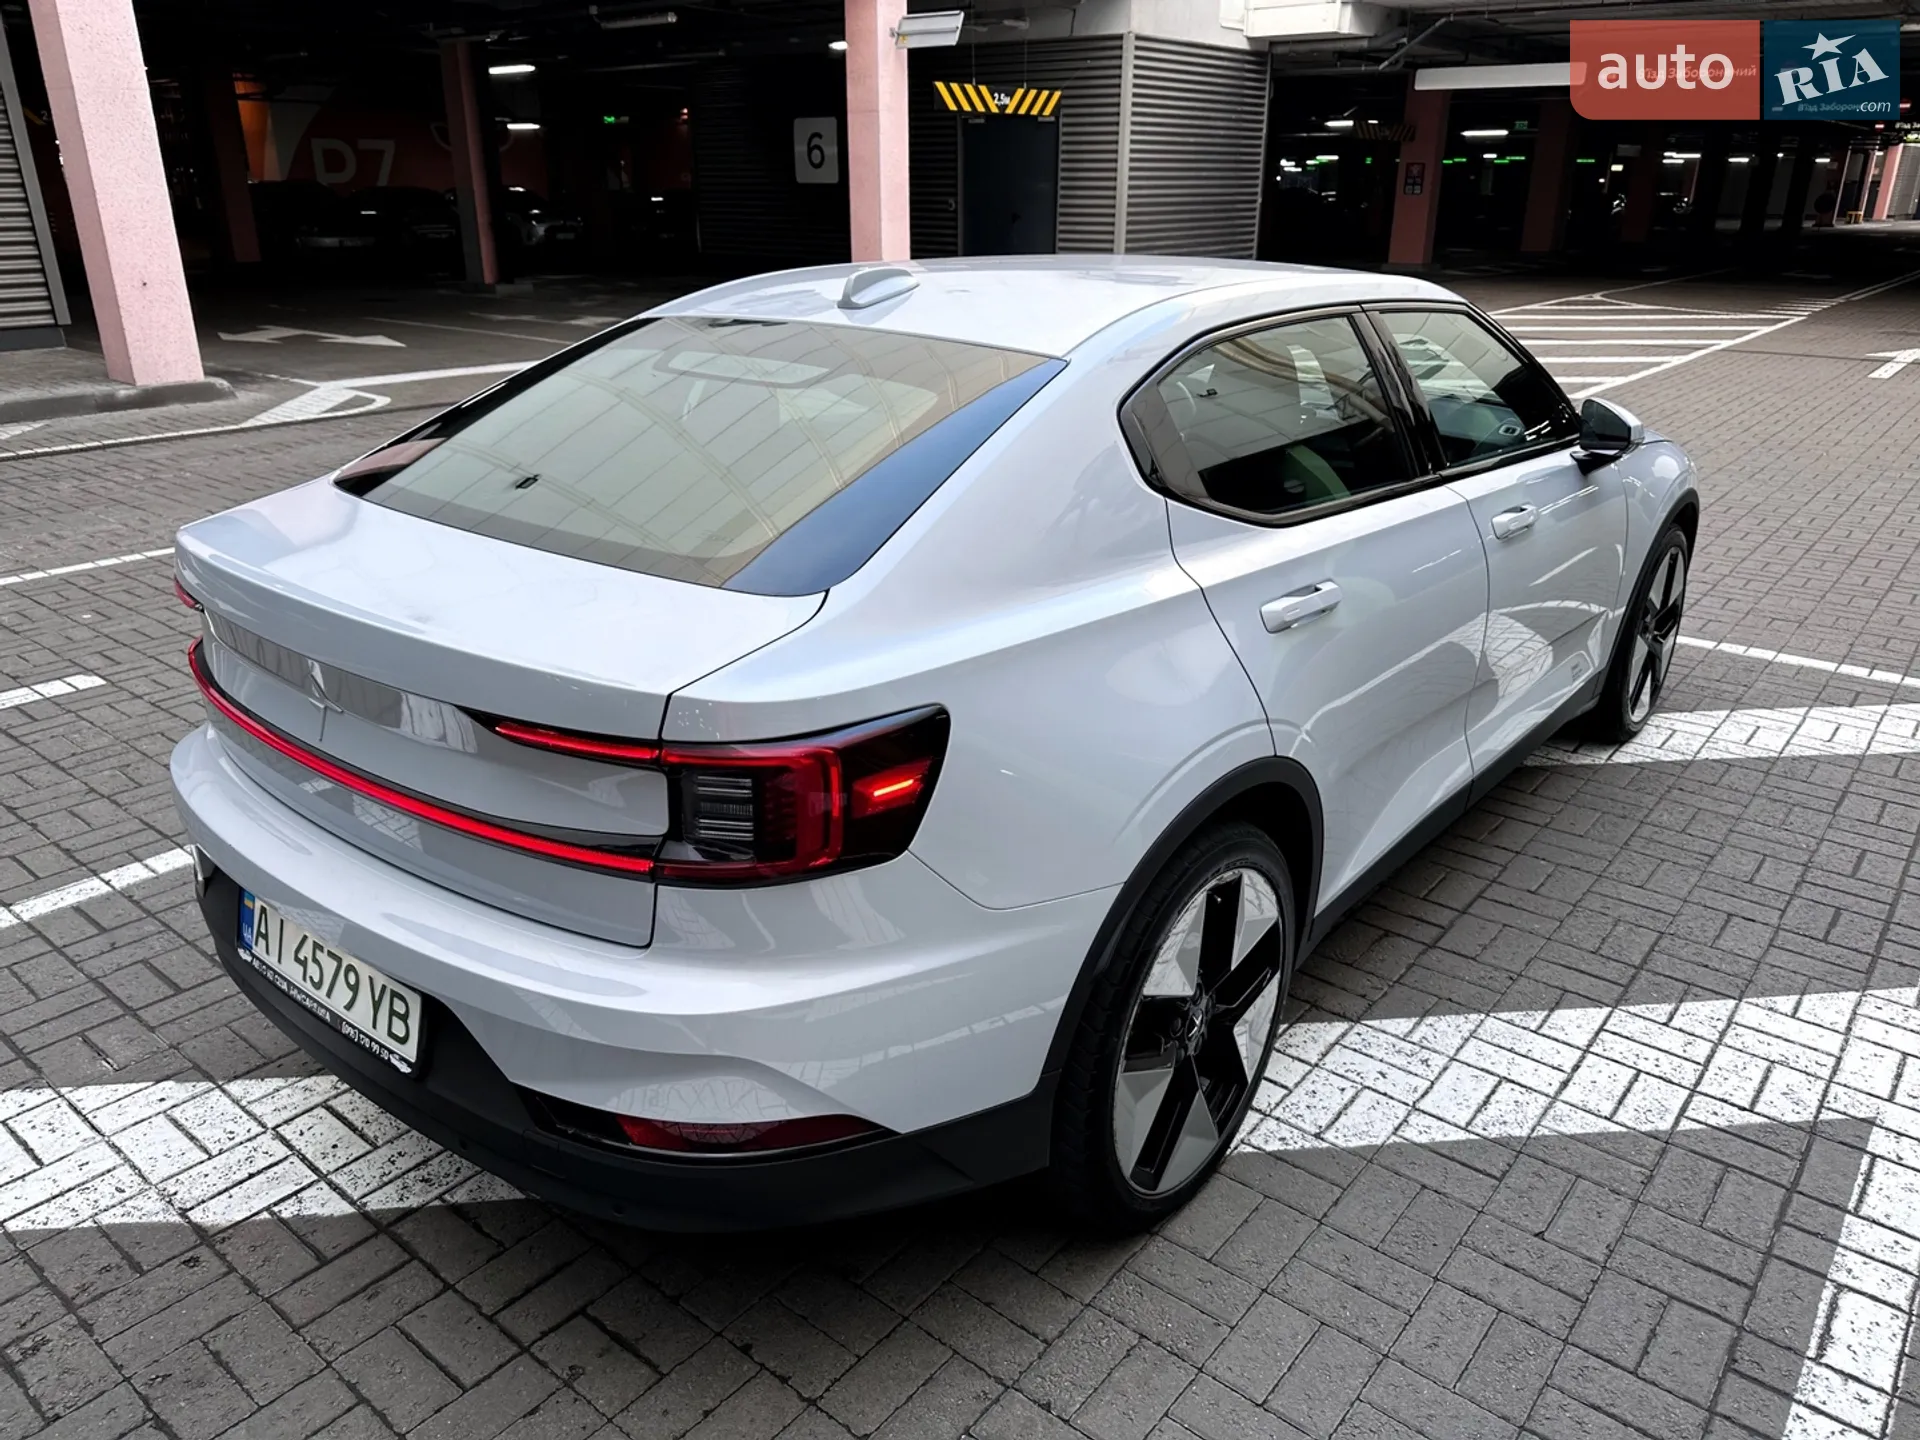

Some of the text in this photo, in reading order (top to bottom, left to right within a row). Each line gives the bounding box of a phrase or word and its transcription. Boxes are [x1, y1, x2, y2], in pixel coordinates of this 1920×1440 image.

[1668, 65, 1758, 81] Заборонний
[310, 137, 396, 187] D7
[807, 131, 825, 169] 6
[242, 923, 253, 944] UA
[255, 905, 284, 965] AI
[294, 934, 360, 1012] 4579
[368, 975, 410, 1045] YB
